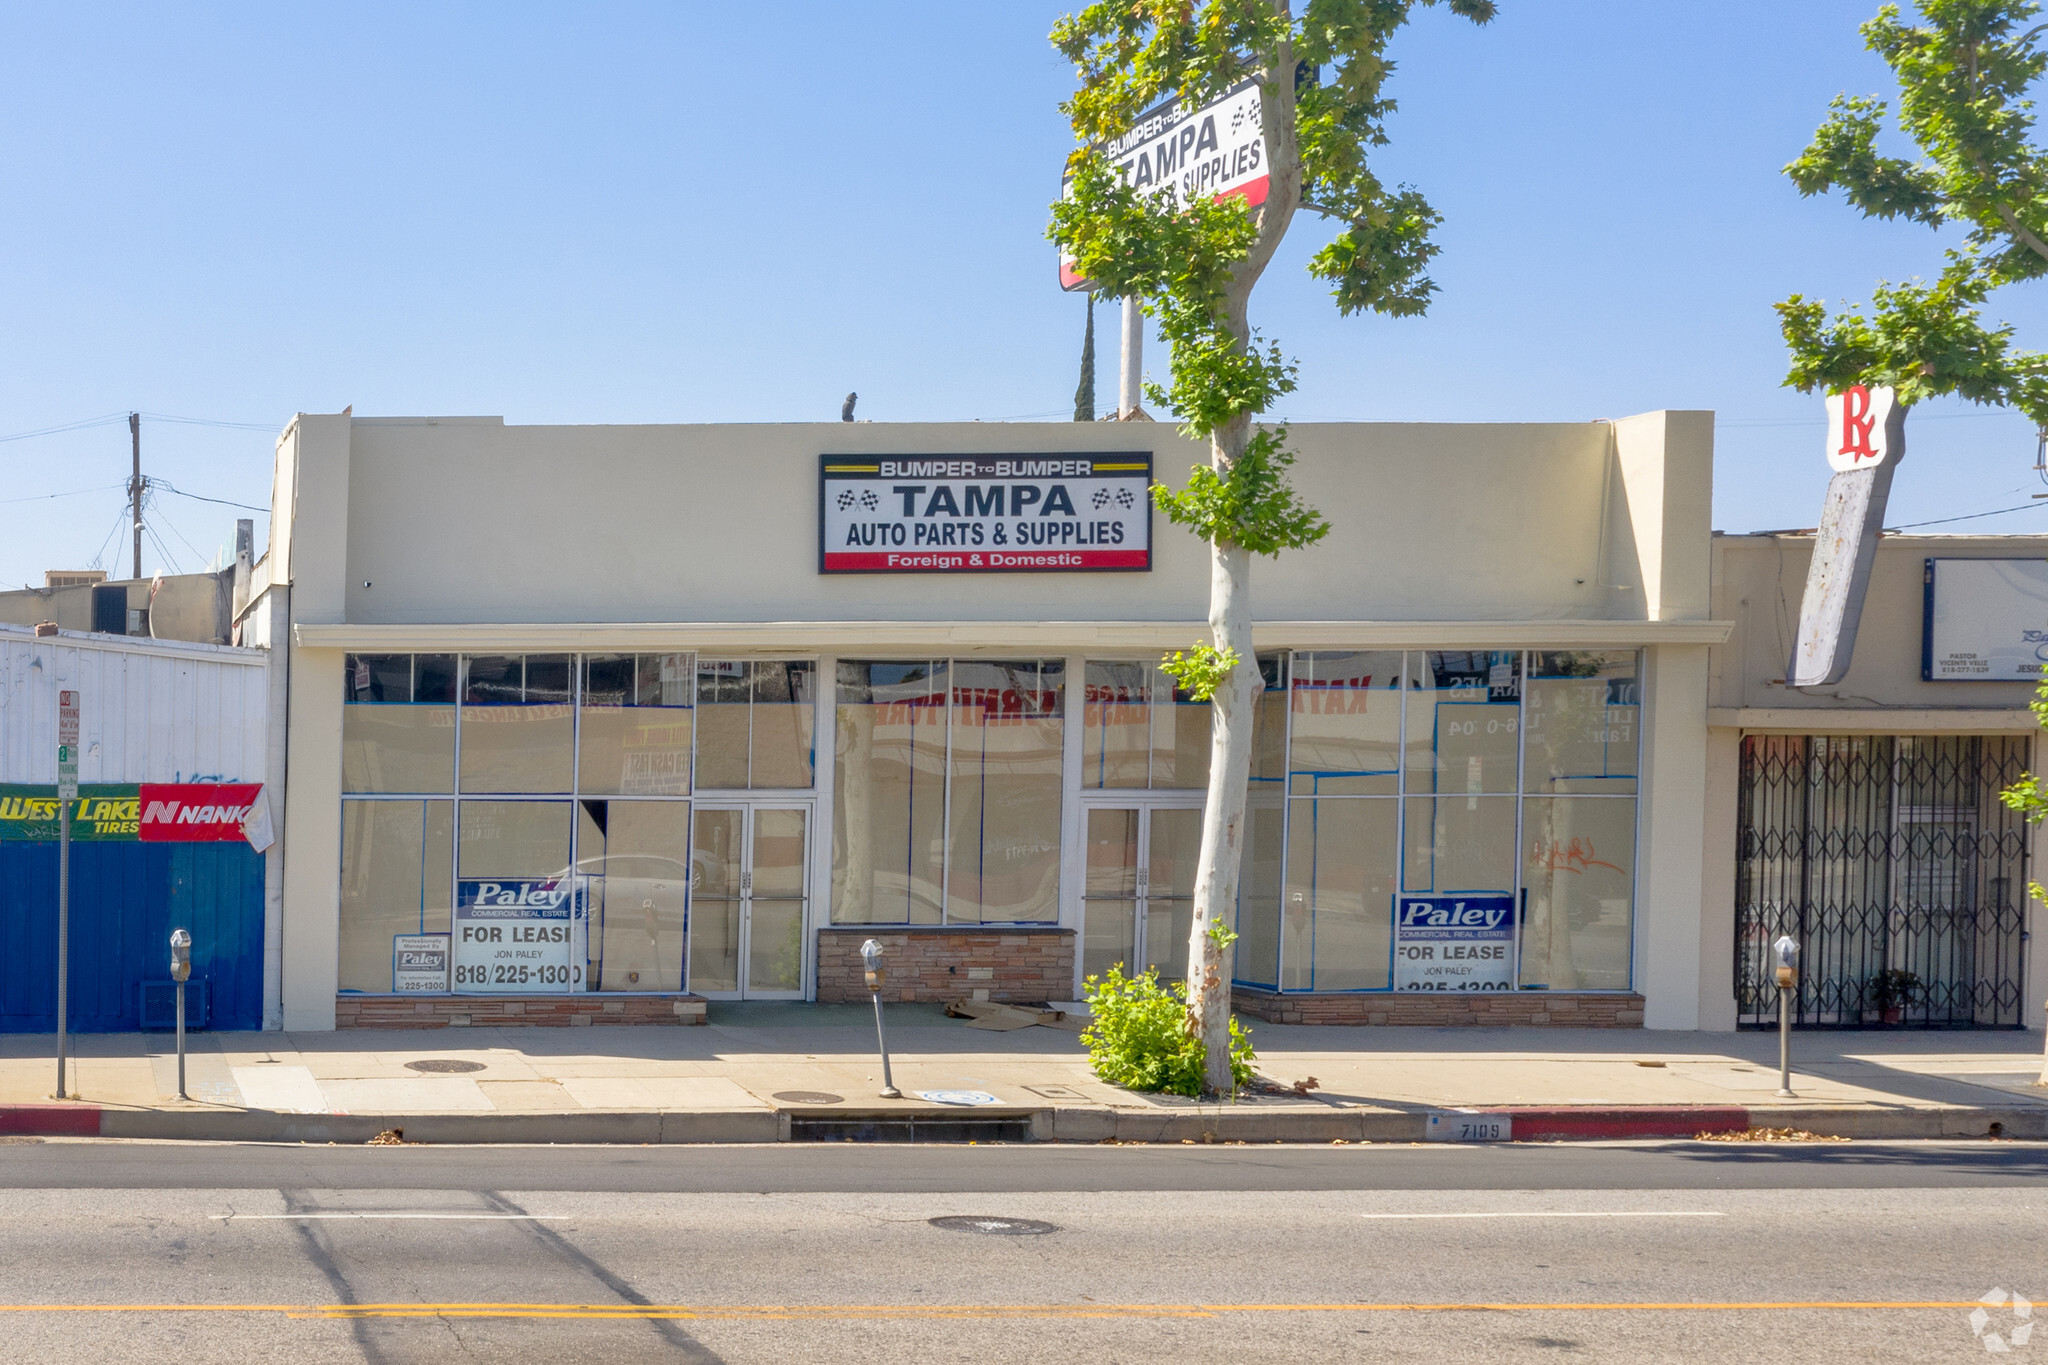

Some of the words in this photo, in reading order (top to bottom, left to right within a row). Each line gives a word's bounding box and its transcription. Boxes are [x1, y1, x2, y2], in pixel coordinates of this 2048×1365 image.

[1108, 114, 1163, 161] BUMPER
[1119, 114, 1219, 189] TAMPA
[1183, 138, 1261, 202] SUPPLIES
[881, 461, 976, 477] BUMPER
[995, 460, 1091, 476] BUMPER
[893, 485, 1077, 517] TAMPA
[846, 523, 906, 546] AUTO
[914, 523, 985, 546] PARTS
[992, 523, 1008, 546] &
[1015, 521, 1125, 545] SUPPLIES
[887, 554, 962, 568] Foreign
[969, 554, 984, 566] &
[989, 553, 1082, 566] Domestic
[61, 692, 71, 706] NO
[60, 747, 67, 761] 2
[76, 799, 140, 821] LAKE
[94, 821, 140, 834] TIRES
[474, 883, 568, 909] Paley
[1401, 902, 1507, 930] Paley
[463, 927, 502, 943] FOR
[401, 952, 442, 966] Paley
[494, 951, 512, 959] JON
[516, 951, 543, 959] PALEY
[1399, 946, 1434, 960] FOR
[1443, 946, 1505, 960] LEASE
[456, 963, 581, 985] 818/225-1300
[1424, 967, 1442, 975] JON
[1445, 967, 1473, 975] PALEY
[405, 982, 444, 990] 225-1300
[1461, 1124, 1500, 1138] 7109
